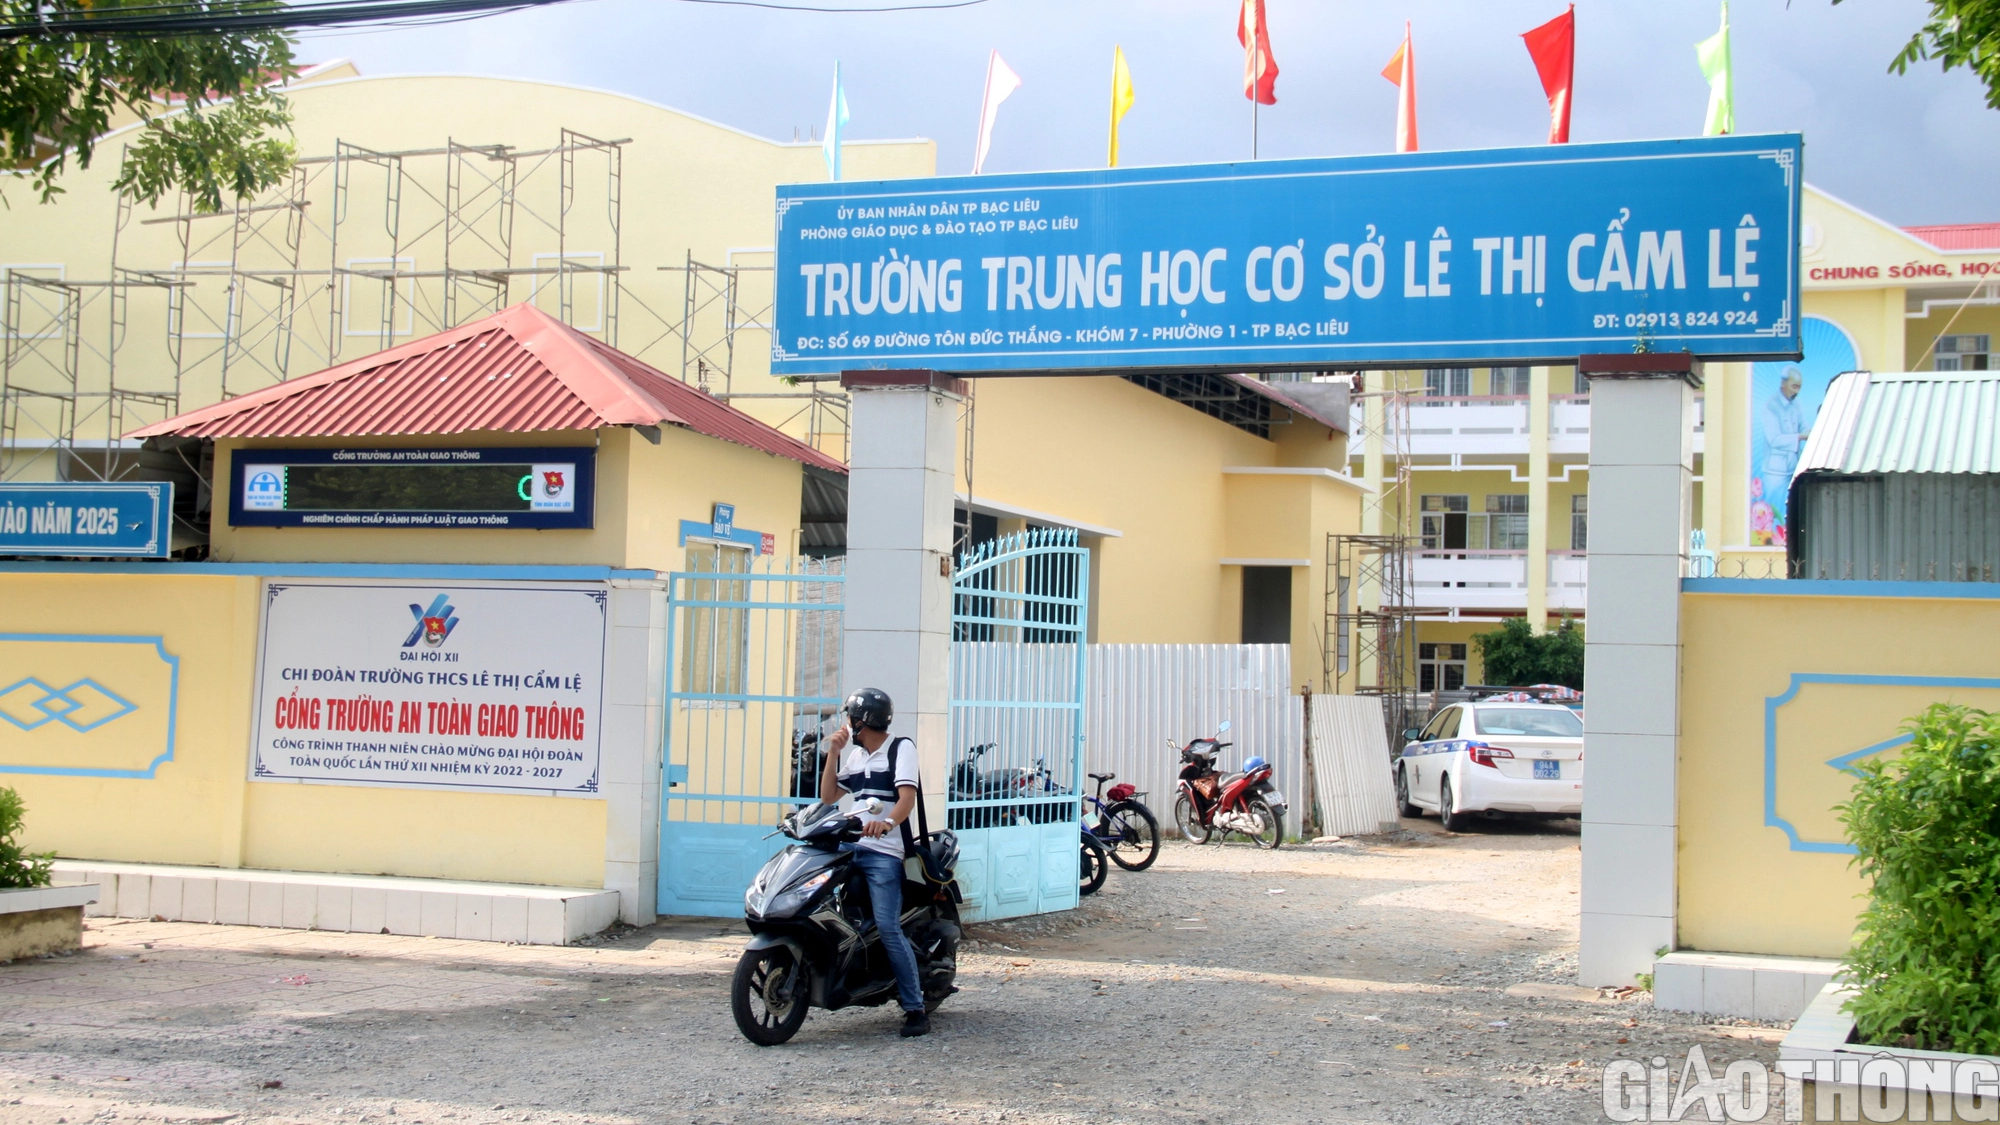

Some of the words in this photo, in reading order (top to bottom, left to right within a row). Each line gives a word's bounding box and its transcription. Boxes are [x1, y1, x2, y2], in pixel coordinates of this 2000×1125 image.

[838, 205, 854, 220] ỦY
[858, 207, 884, 219] BAN
[889, 203, 926, 217] NHÂN
[930, 201, 958, 215] DÂN
[962, 203, 977, 214] TP
[981, 201, 1009, 216] BẠC
[1014, 198, 1040, 212] LIÊU
[801, 226, 848, 239] PHÒNG
[851, 224, 886, 238] GIÁO
[890, 225, 918, 238] DỤC
[922, 224, 931, 235] &
[935, 220, 966, 235] ĐÀO
[968, 220, 997, 236] TẠO
[1000, 220, 1015, 231] TP
[1019, 219, 1047, 233] BẠC
[1052, 216, 1078, 230] LIÊU
[801, 248, 962, 316] TRƯỜNG
[982, 253, 1122, 311] TRUNG
[1141, 248, 1227, 318] HỌC
[1246, 239, 1304, 302] CƠ
[1324, 224, 1385, 300] SỞ
[1404, 227, 1451, 297] LÊ
[1473, 236, 1546, 307] THỊ
[1568, 208, 1686, 292] CẨM
[1709, 214, 1759, 301] LỆ
[1809, 265, 1879, 281] CHUNG
[1887, 259, 1953, 279] SỐNG,
[1594, 315, 1619, 328] ĐT:
[1626, 313, 1679, 327] 02913
[1686, 312, 1718, 326] 824
[1724, 311, 1758, 324] 924
[797, 337, 823, 349] ĐC:
[828, 331, 848, 348] SỐ
[852, 335, 870, 348] 69
[874, 331, 930, 347] ĐƯỜNG
[935, 330, 965, 346] TÔN
[970, 329, 1003, 345] ĐỨC
[1008, 325, 1062, 344] THẮNG
[1076, 326, 1124, 342] KHÓM
[1130, 328, 1138, 341] 7
[1153, 323, 1223, 340] PHƯỜNG
[1230, 325, 1235, 337] 1
[1252, 324, 1270, 337] TP
[1276, 323, 1310, 339] BẠC
[1317, 319, 1348, 335] LIÊU
[357, 450, 391, 460] TRƯỜNG
[392, 452, 405, 460] AN
[406, 450, 429, 460] TOÀN
[430, 451, 450, 460] GIAO
[451, 450, 480, 460] THÔNG
[32, 502, 71, 533] NĂM
[76, 508, 117, 534] 2025
[303, 514, 334, 524] NGHIÊM
[361, 513, 384, 524] CHẤP
[386, 515, 408, 524] HÀNH
[411, 514, 434, 524] PHÁP
[434, 516, 456, 526] LUẬT
[458, 516, 478, 525] GIAO
[479, 515, 509, 525] THÔNG
[399, 651, 418, 663] ĐẠI
[421, 648, 441, 664] HỘI
[444, 652, 459, 663] XII
[281, 667, 309, 682] CHI
[311, 663, 356, 683] ĐOÀN
[359, 664, 424, 685] TRƯỜNG
[428, 671, 469, 687] THCS
[472, 667, 489, 687] LÊ
[495, 673, 520, 690] THỊ
[523, 669, 560, 690] CẨM
[564, 672, 582, 693] LỆ
[274, 685, 321, 731] CỔNG
[327, 694, 394, 734] TRƯỜNG
[397, 701, 421, 734] AN
[428, 697, 472, 737] TOÀN
[477, 703, 519, 739] GIAO
[525, 701, 585, 742] THÔNG
[272, 736, 305, 751] CÔNG
[308, 737, 343, 752] TRÌNH
[346, 740, 387, 753] THANH
[389, 739, 419, 755] NIÊN
[421, 741, 454, 757] CHÀO
[457, 743, 495, 759] MỪNG
[498, 746, 520, 761] ĐẠI
[522, 746, 545, 761] HỘI
[547, 746, 584, 762] ĐOÀN
[289, 753, 321, 768] TOÀN
[323, 755, 356, 771] QUỐC
[359, 755, 381, 771] LẦN
[384, 756, 410, 772] THỨ
[412, 761, 428, 772] XII
[430, 759, 472, 777] NHIỆM
[474, 761, 491, 775] KỲ
[493, 765, 523, 777] 2022
[533, 767, 563, 779] 2027
[1540, 760, 1553, 769] 94A
